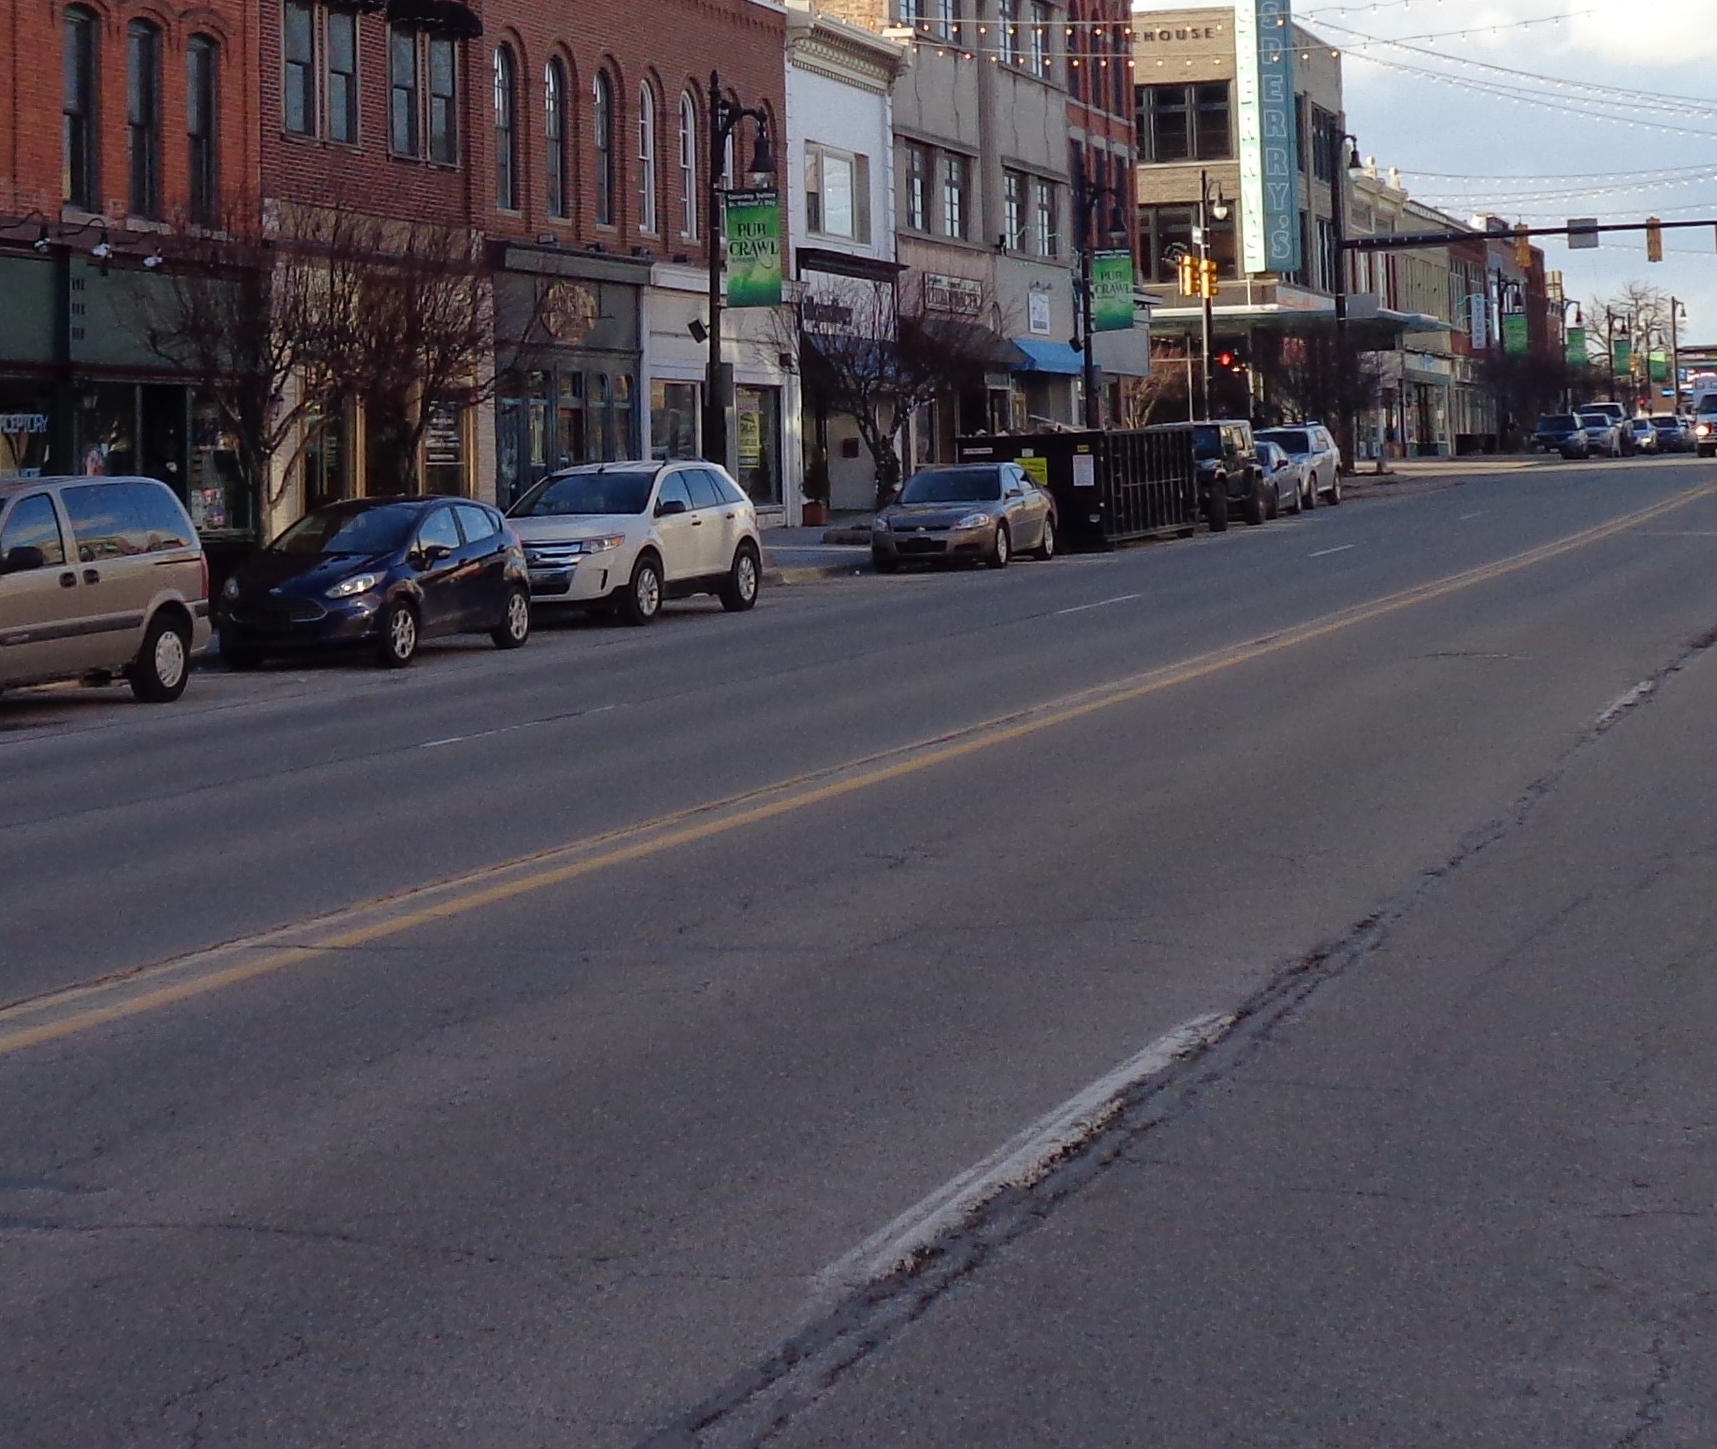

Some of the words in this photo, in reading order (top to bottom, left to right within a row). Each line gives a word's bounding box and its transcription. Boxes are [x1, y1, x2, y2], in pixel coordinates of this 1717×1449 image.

[1260, 2, 1290, 258] SPERRY'S
[737, 223, 766, 237] PUB
[729, 241, 779, 257] CRAWL
